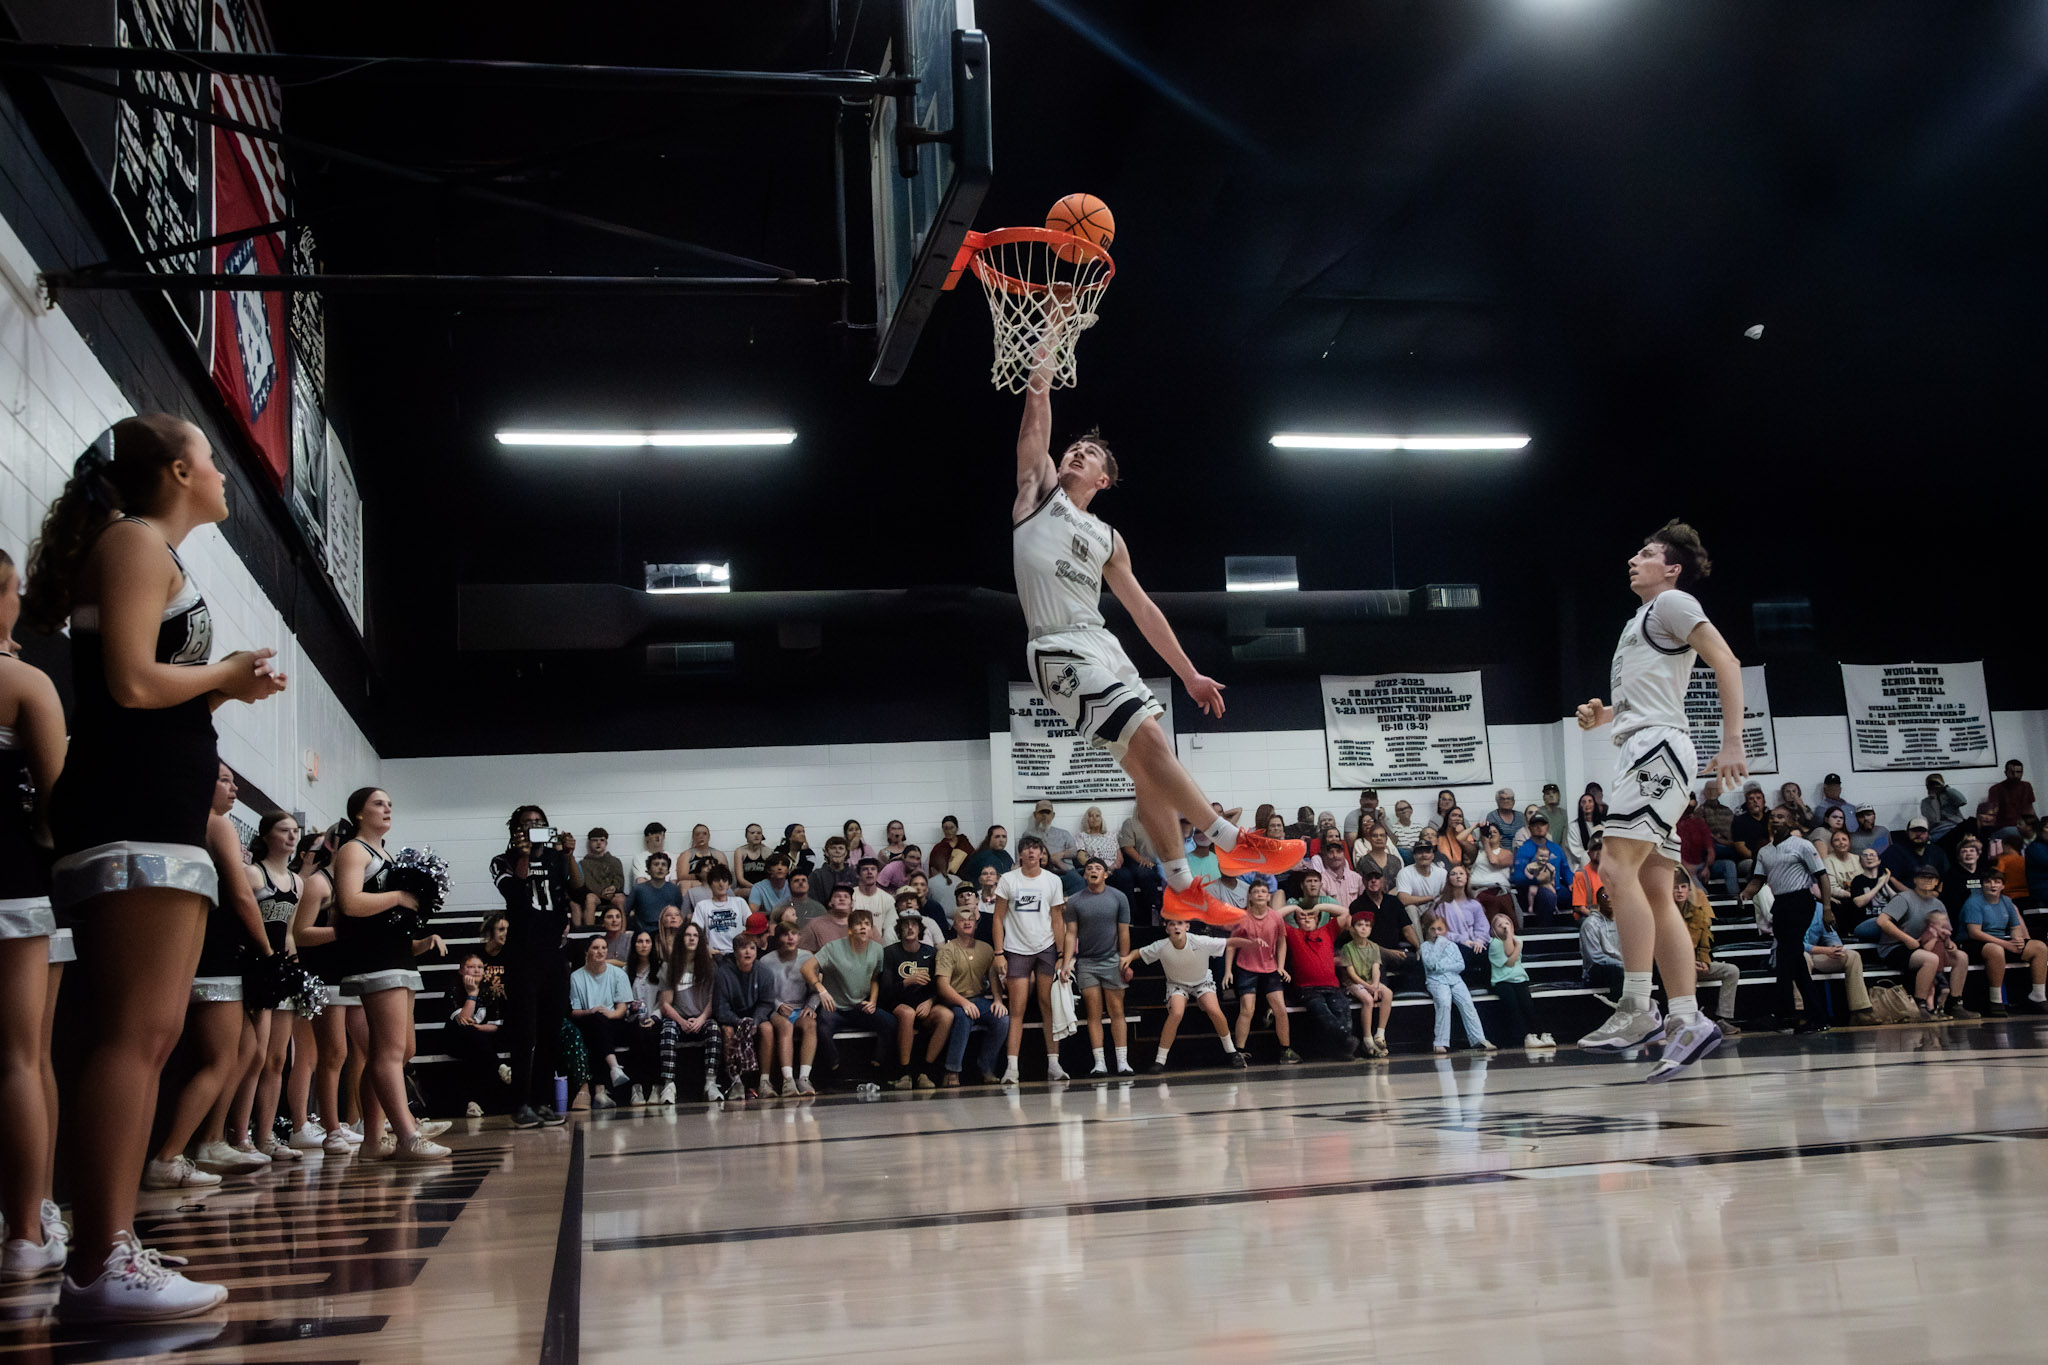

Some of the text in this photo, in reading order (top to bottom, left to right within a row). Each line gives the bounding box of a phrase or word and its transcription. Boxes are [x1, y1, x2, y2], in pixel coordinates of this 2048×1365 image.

[1691, 672, 1716, 680] DLAW
[1883, 667, 1939, 676] WOODLAWN
[1375, 678, 1425, 688] 2022-2023
[1706, 682, 1718, 690] BO
[1882, 677, 1944, 686] SENIOR BOYS
[1364, 689, 1389, 697] BOYS
[1392, 687, 1453, 695] BASKETBALL
[1883, 688, 1945, 696] BASKETBALL
[1030, 698, 1044, 706] SR
[1355, 696, 1417, 706] CONFERENCE
[1419, 695, 1472, 704] RUNNER-UP
[1360, 706, 1403, 715] DISTRICT
[1406, 703, 1471, 713] TOURNAMENT
[1378, 714, 1432, 723] RUNNER-UP
[1034, 719, 1069, 728] STATE
[1382, 722, 1429, 732] 15-10 (9-3)
[1047, 729, 1078, 738] SWEE
